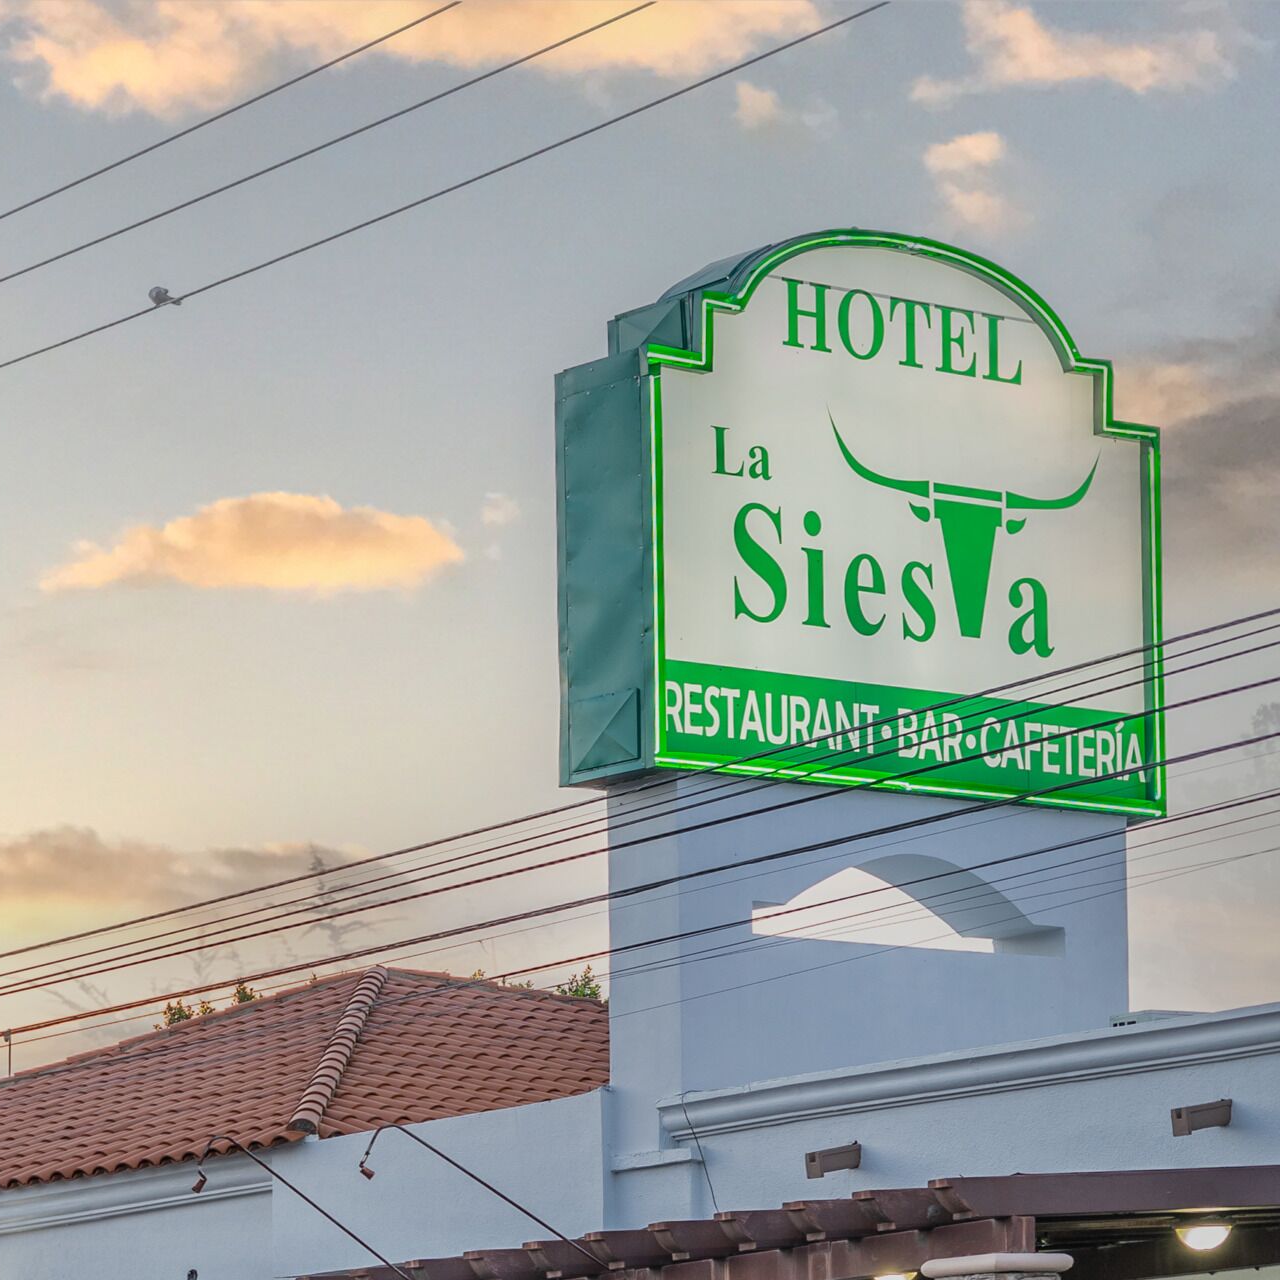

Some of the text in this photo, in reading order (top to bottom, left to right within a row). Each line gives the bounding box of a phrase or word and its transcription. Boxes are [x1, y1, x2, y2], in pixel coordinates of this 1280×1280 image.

[782, 277, 1023, 386] HOTEL
[710, 424, 773, 481] La
[665, 680, 1147, 784] RESTAURANT BAR CAFETERÍA
